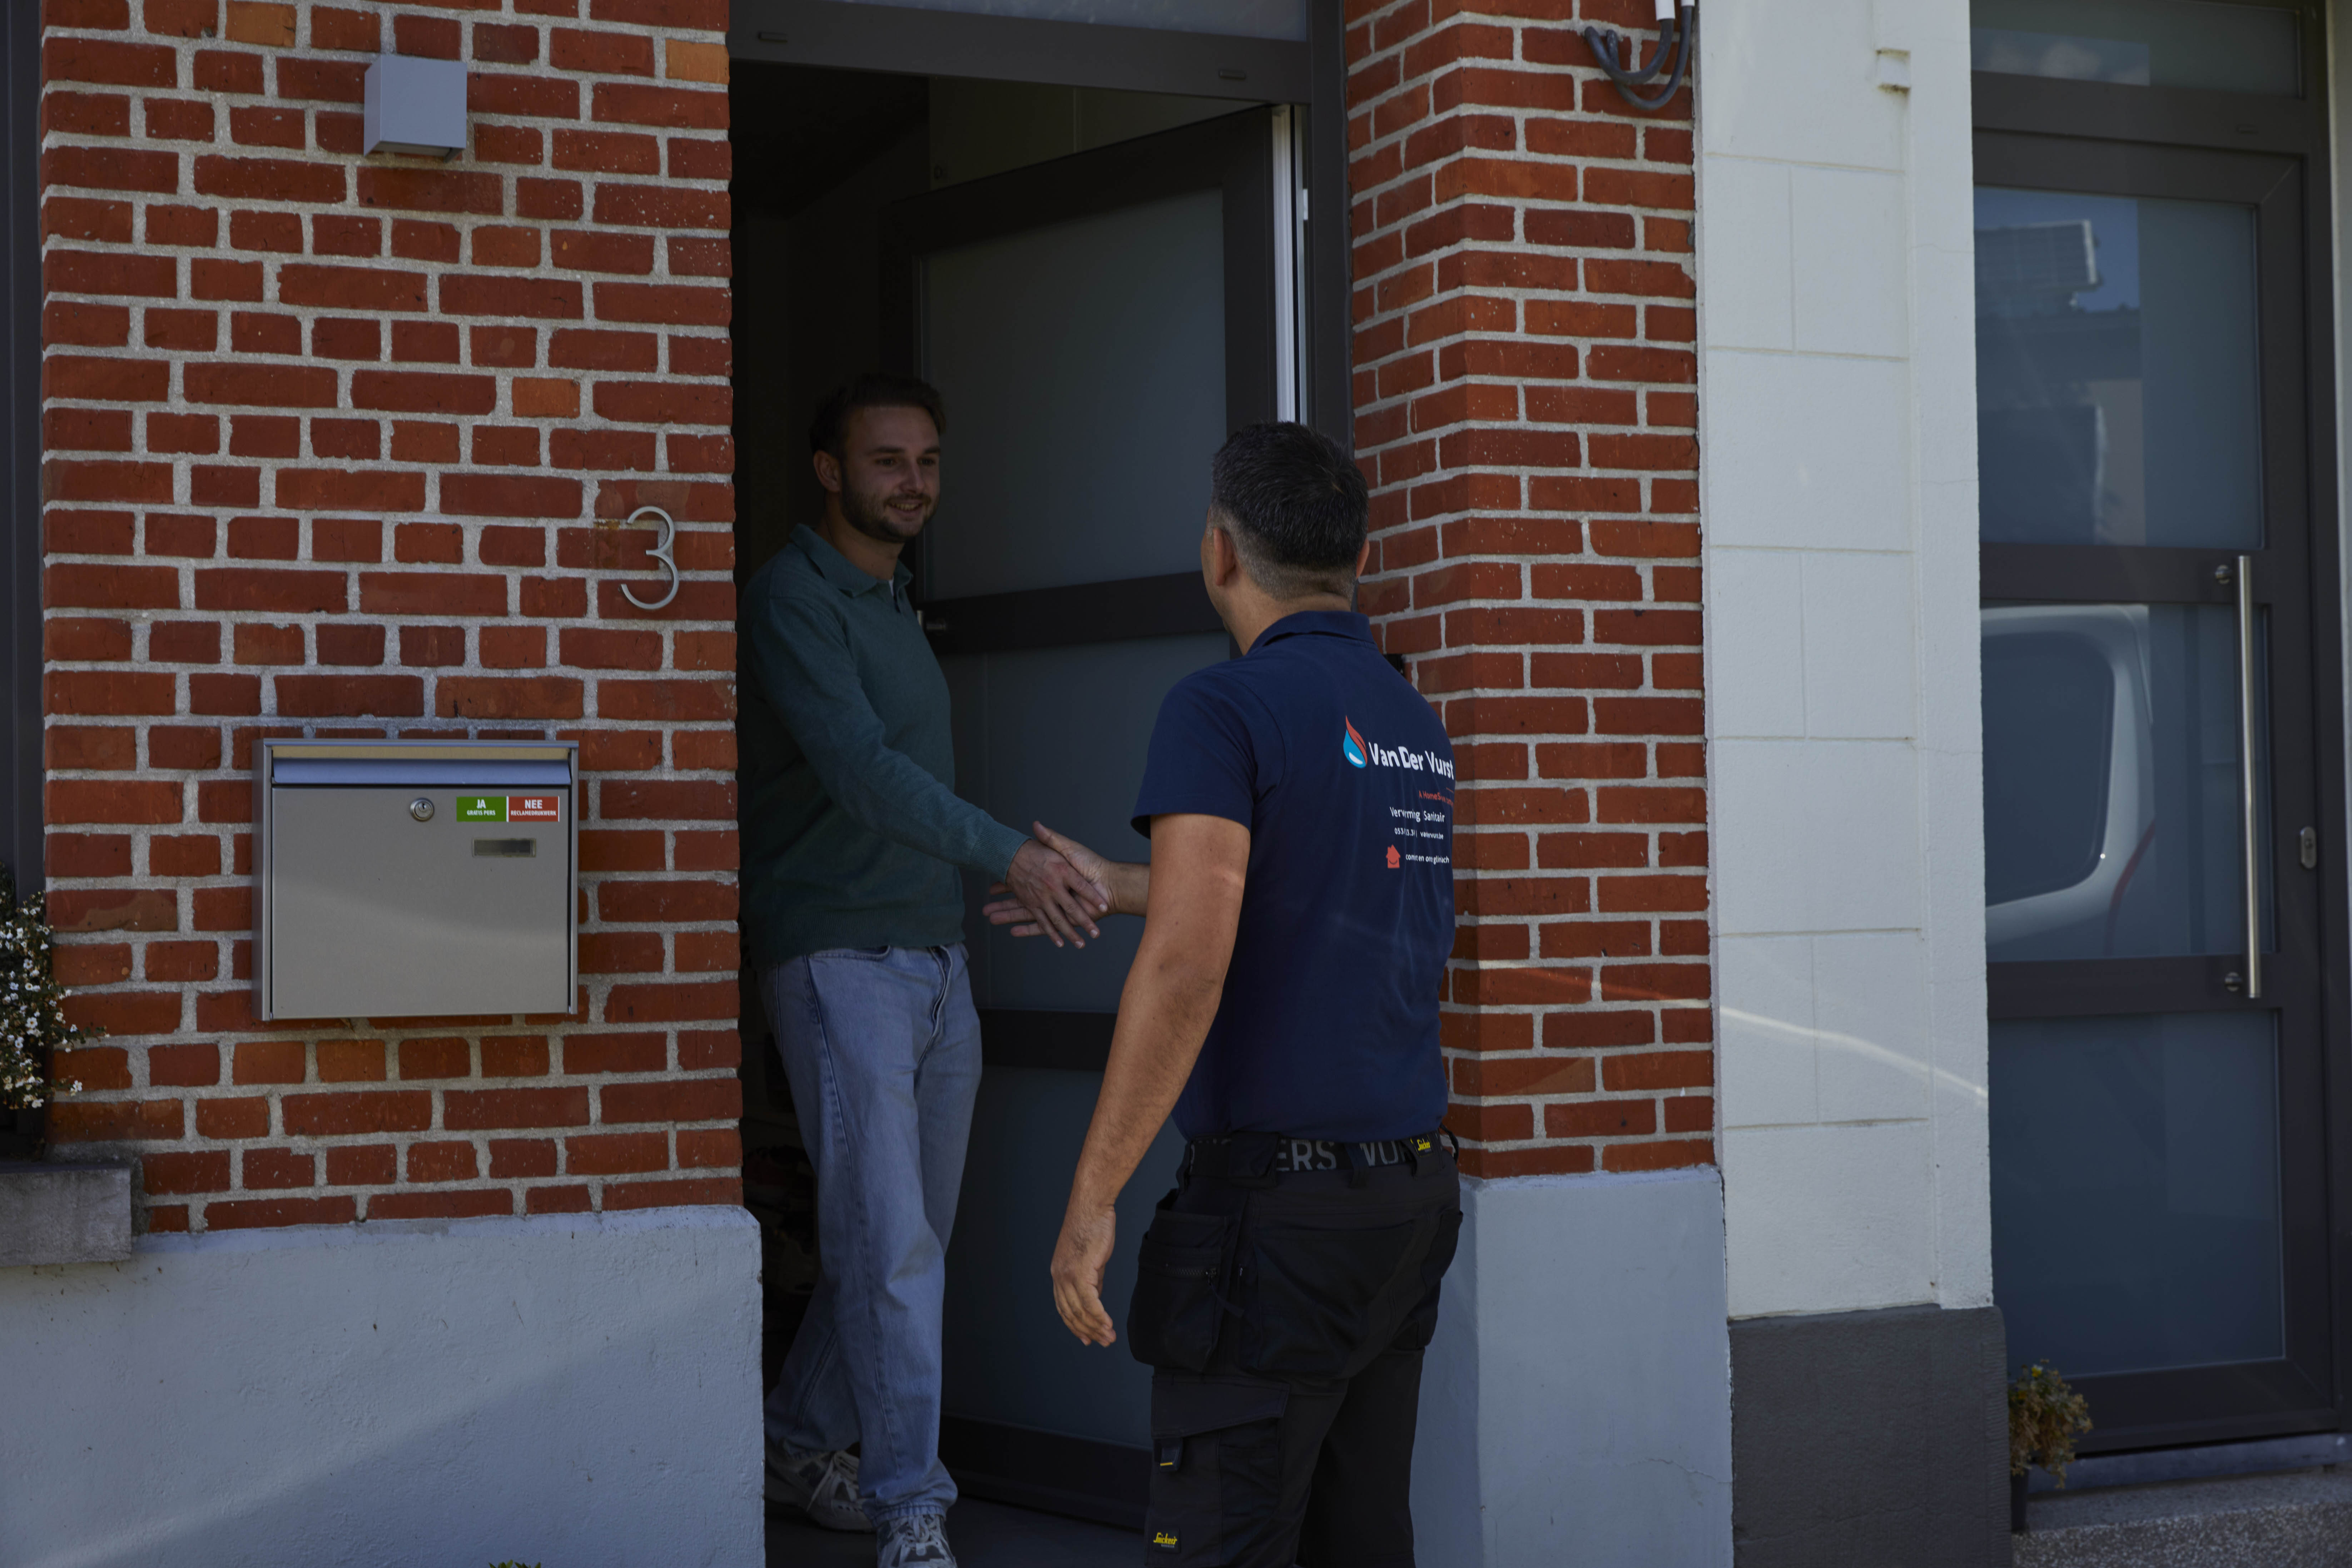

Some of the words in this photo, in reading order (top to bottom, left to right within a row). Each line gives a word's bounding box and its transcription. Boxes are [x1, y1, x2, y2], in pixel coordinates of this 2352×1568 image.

[621, 506, 679, 609] 3
[1425, 750, 1454, 780] Vurst
[476, 799, 486, 809] JA
[524, 799, 543, 809] NEE
[1389, 806, 1421, 823] Verwrming
[1423, 810, 1445, 823] Sanitair
